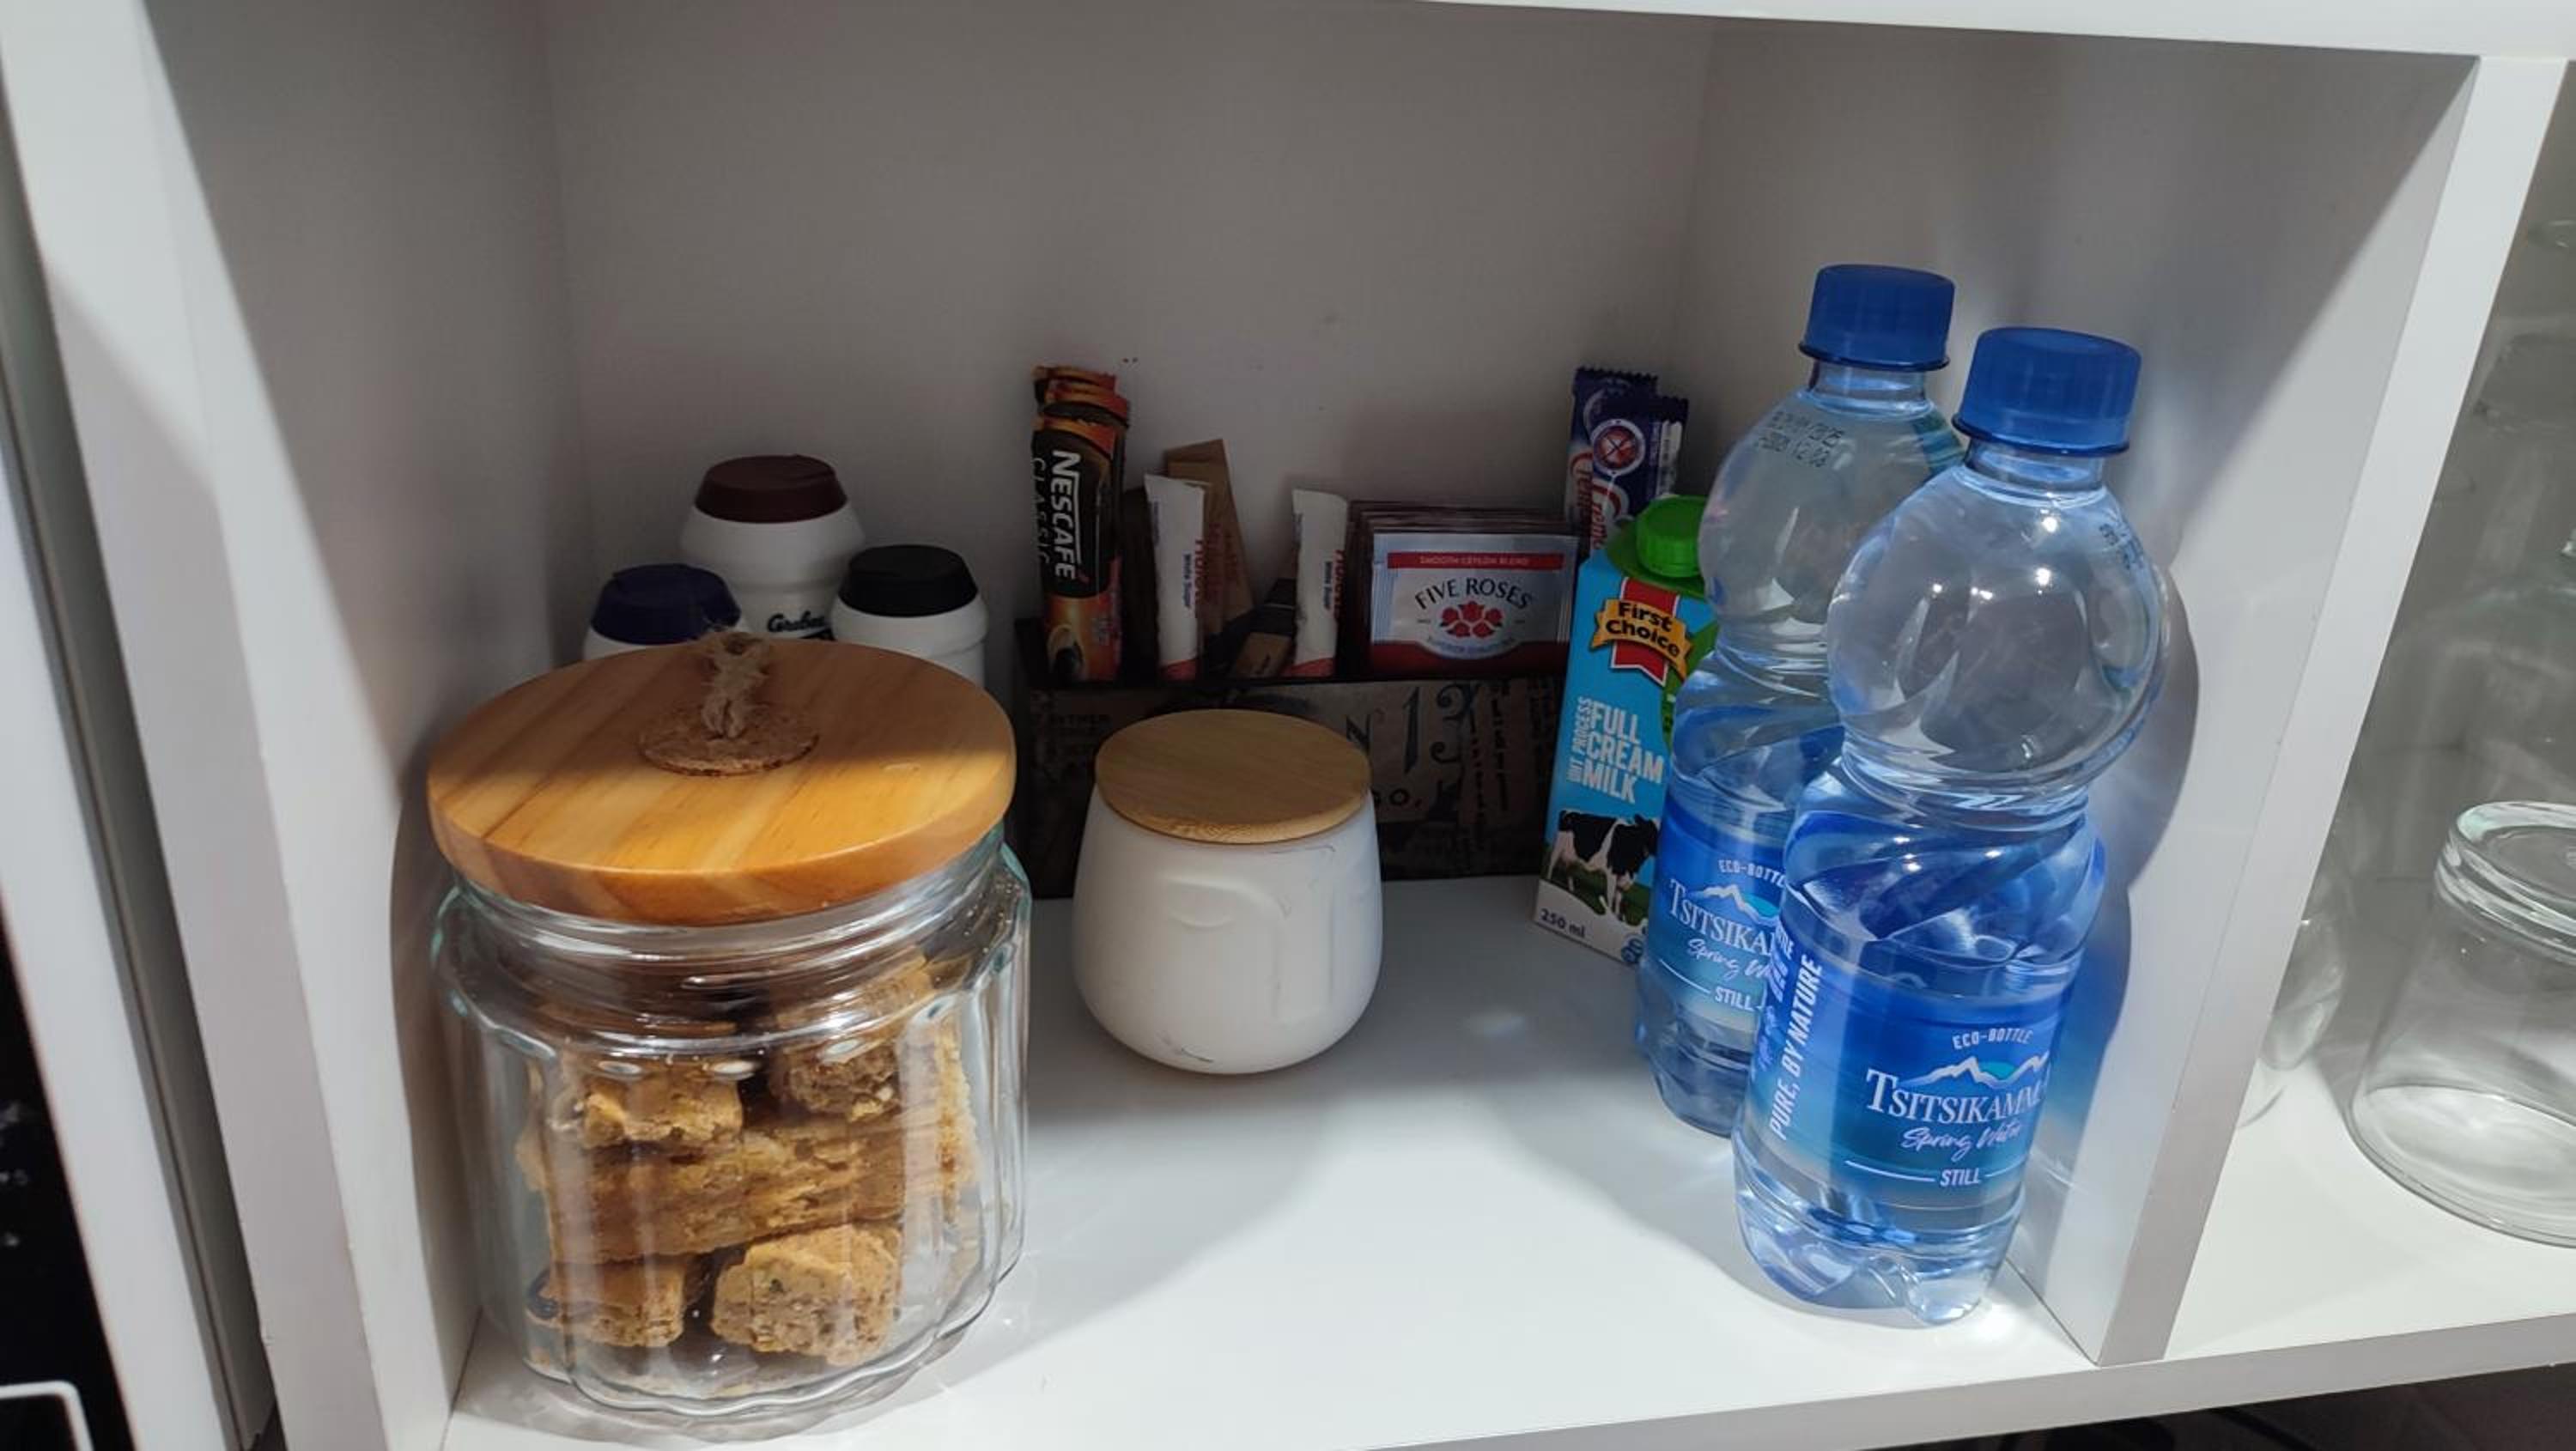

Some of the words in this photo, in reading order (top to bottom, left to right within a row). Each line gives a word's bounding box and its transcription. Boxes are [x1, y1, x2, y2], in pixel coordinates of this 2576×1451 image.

[1415, 578, 1459, 610] FIVE
[1466, 577, 1533, 610] ROSES
[1618, 602, 1673, 633] First
[1606, 619, 1680, 658] Choice
[1571, 696, 1592, 756] PROCESS
[1591, 701, 1641, 745] FULL
[1585, 731, 1664, 785] CREAM
[1582, 758, 1638, 804] MILK
[1718, 859, 1787, 889] ECO-BOTTL
[1540, 908, 1566, 929] 250
[1569, 924, 1586, 938] ml
[1687, 938, 1740, 981] Spring
[1715, 987, 1755, 1011] STILL
[1787, 953, 1823, 1046] NATURE
[1781, 1039, 1806, 1078] BY
[1952, 1028, 2034, 1050] ECO-BOTTLE
[1769, 1077, 1801, 1141] PURE,
[1900, 1126, 1972, 1163] Spring
[1939, 1168, 1982, 1187] STILL
